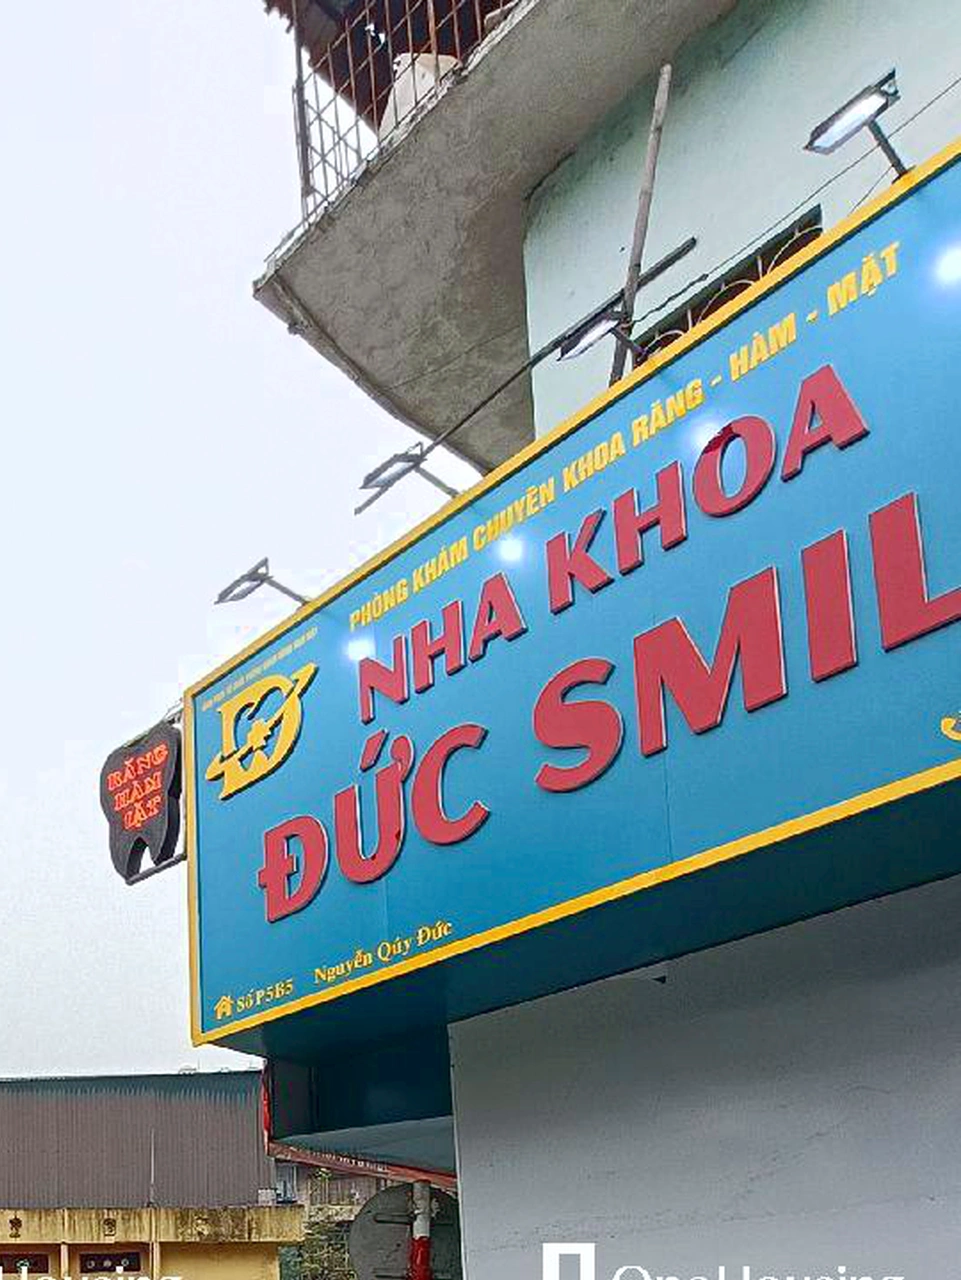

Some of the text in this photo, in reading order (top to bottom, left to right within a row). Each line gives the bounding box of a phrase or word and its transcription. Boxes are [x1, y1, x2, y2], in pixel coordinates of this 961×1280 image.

[349, 578, 410, 632] PHÒNG
[412, 535, 470, 594] KHÁM
[472, 478, 556, 551] CHUYÊN
[561, 431, 627, 493] KHOA
[631, 378, 706, 448] RĂNG
[728, 312, 797, 383] HÀM
[826, 241, 901, 318] MẶT
[358, 571, 529, 724] NHA
[544, 363, 871, 616] KHOA
[257, 491, 961, 923] ĐỨC SMIL
[313, 949, 374, 985] Nguyễn
[415, 919, 453, 947] Đức
